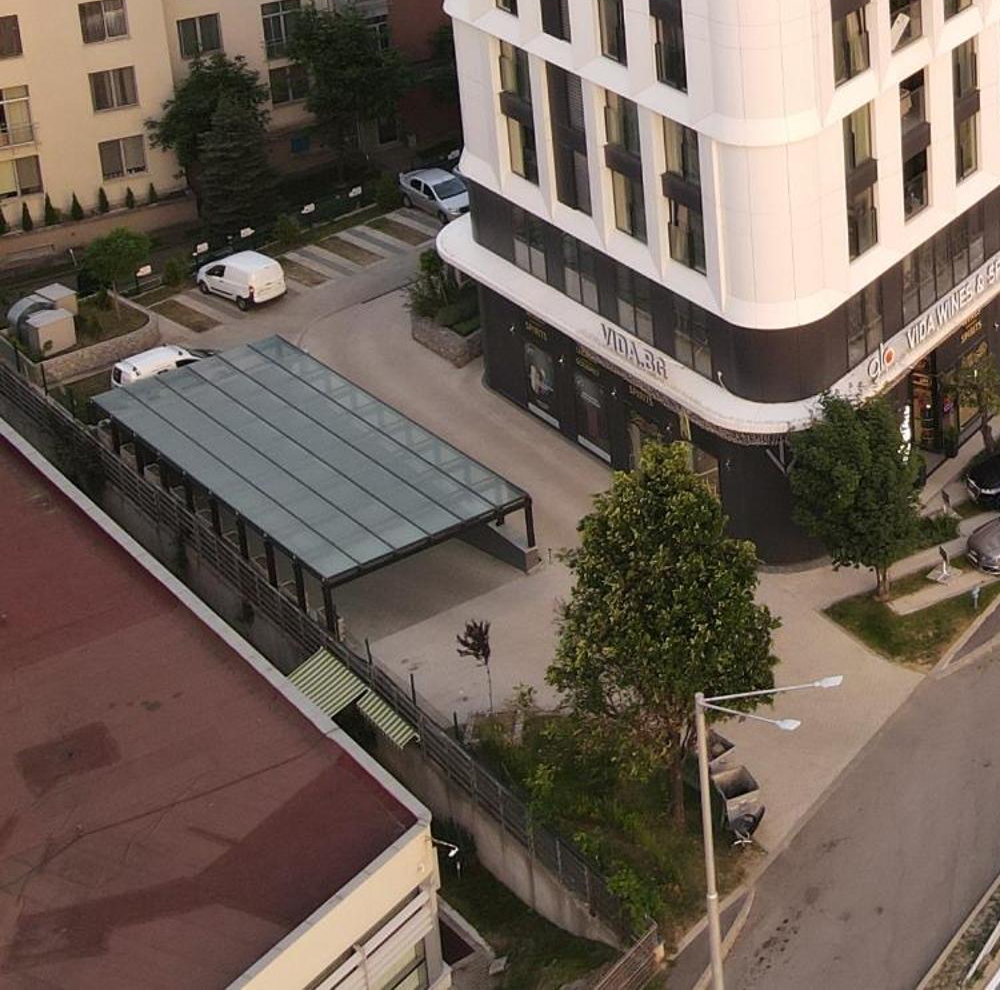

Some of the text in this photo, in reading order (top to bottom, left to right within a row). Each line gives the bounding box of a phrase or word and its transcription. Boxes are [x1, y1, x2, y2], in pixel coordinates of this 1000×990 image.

[905, 319, 937, 349] VIDA
[936, 285, 973, 325] WINES
[975, 274, 986, 293] &
[601, 323, 668, 380] VIDA.BG
